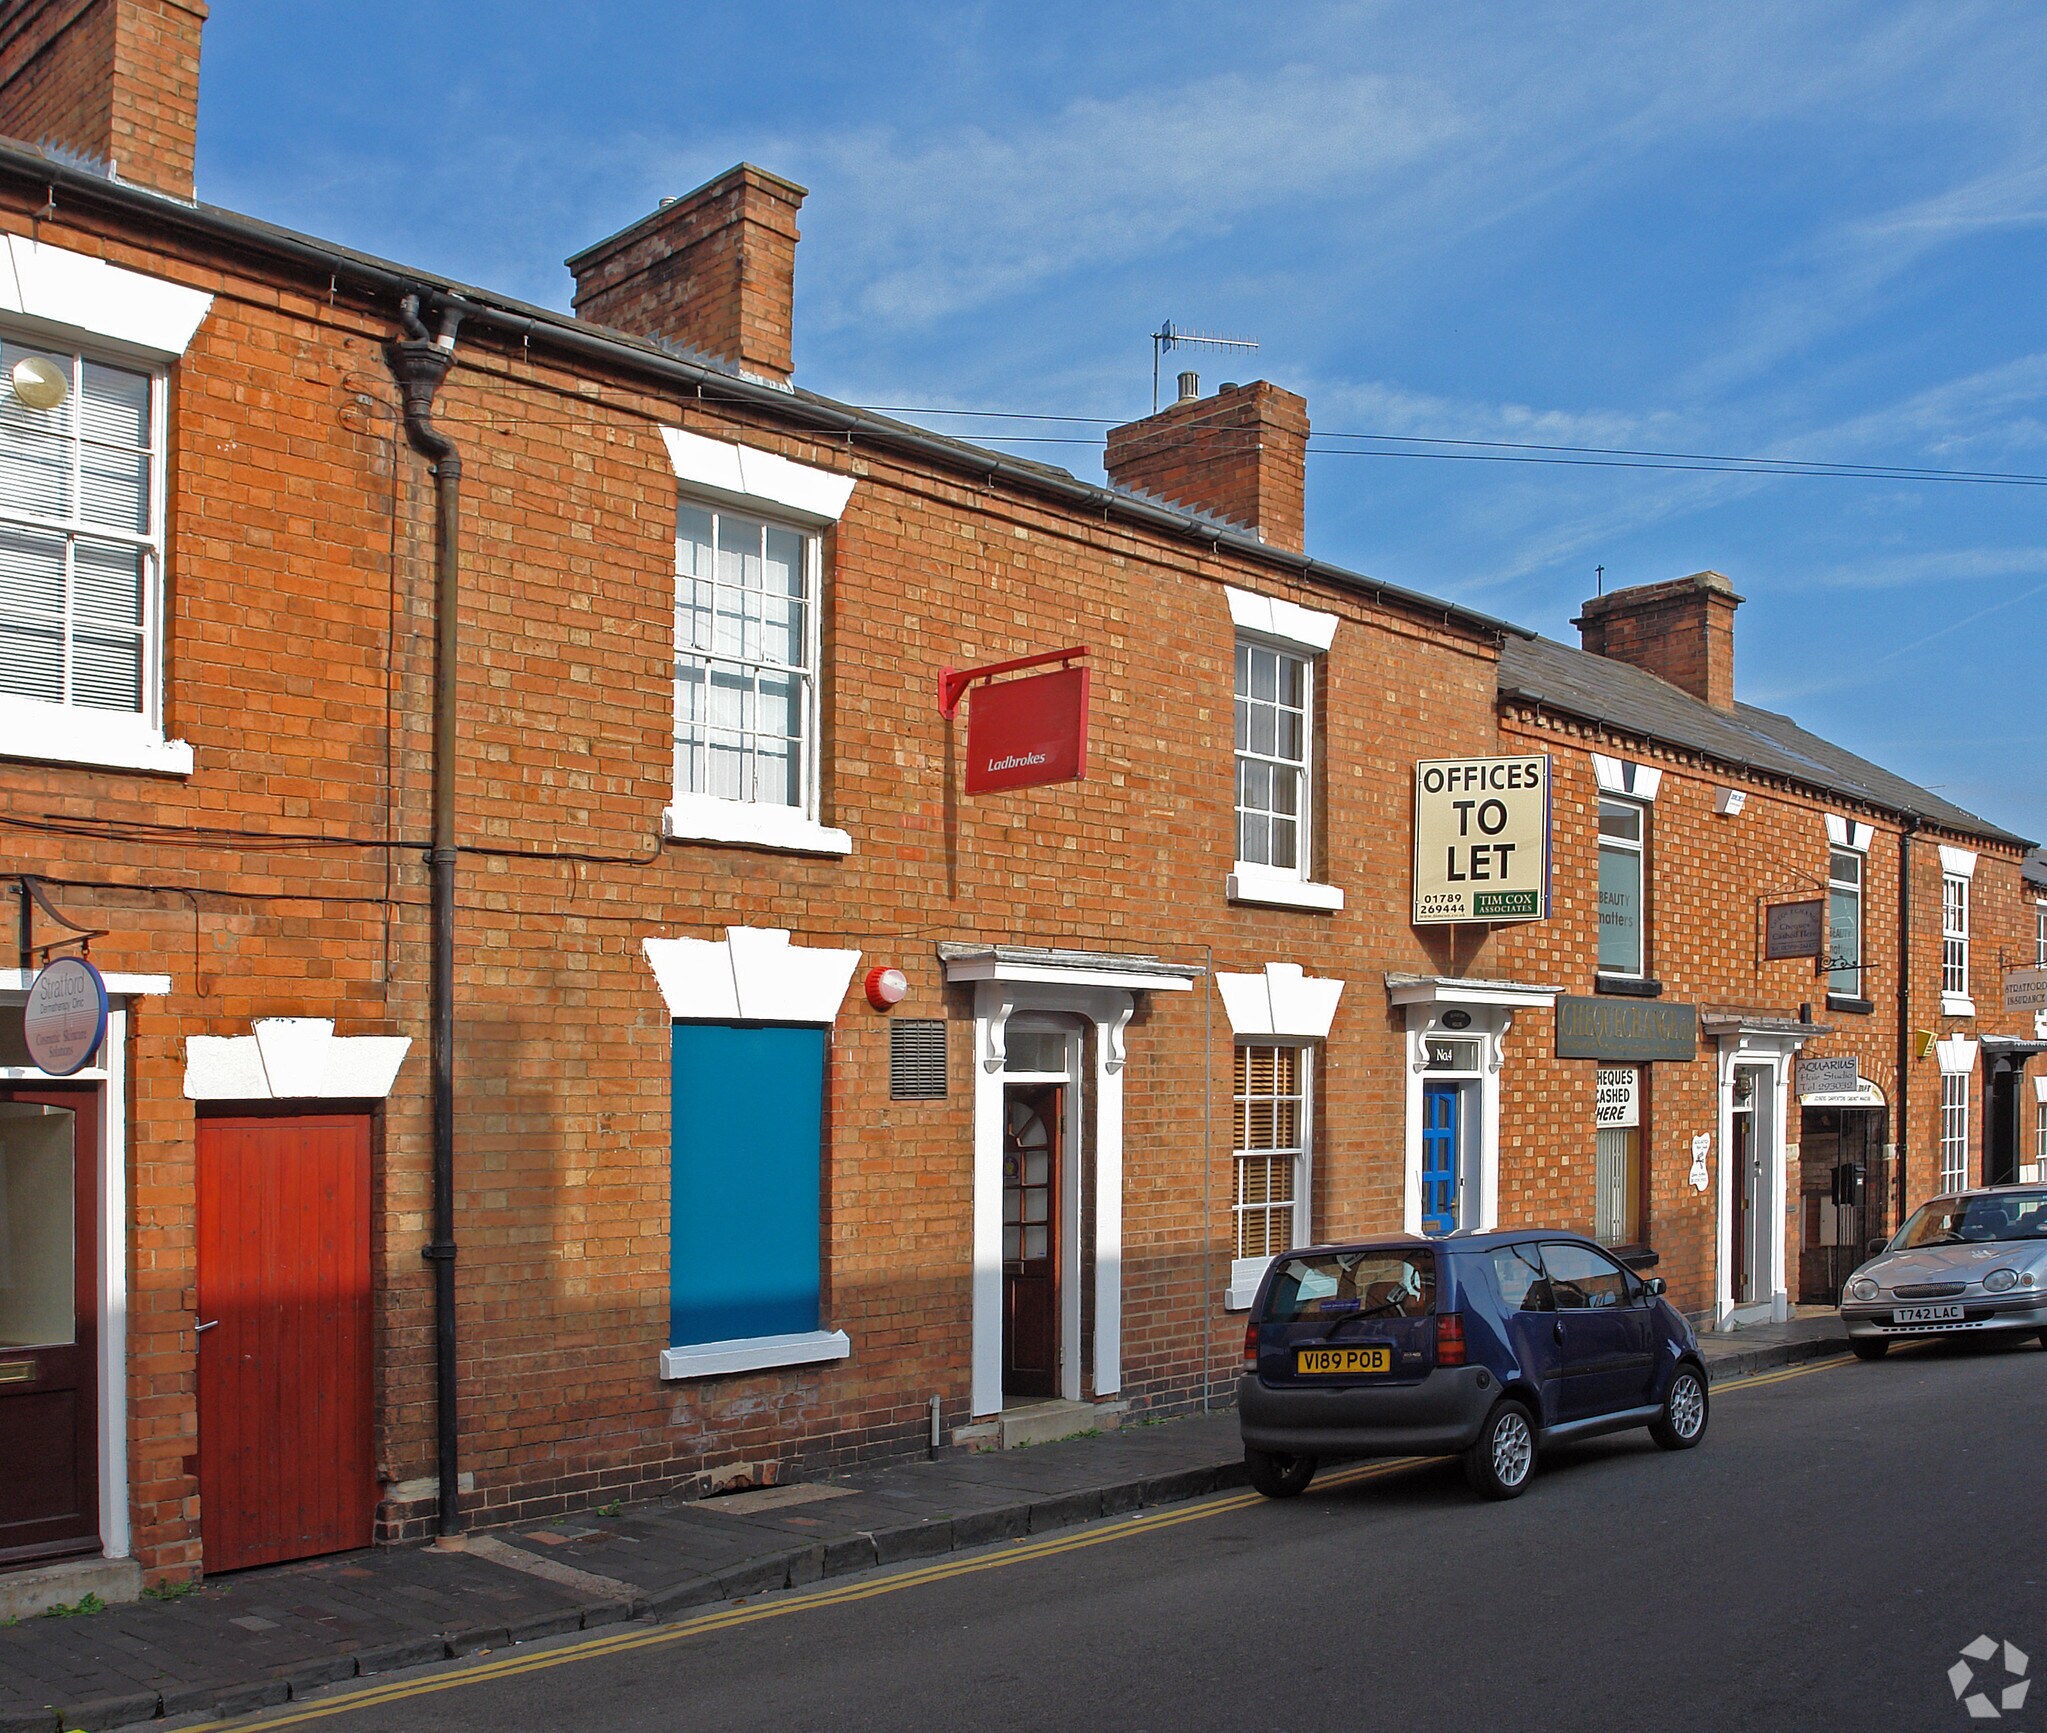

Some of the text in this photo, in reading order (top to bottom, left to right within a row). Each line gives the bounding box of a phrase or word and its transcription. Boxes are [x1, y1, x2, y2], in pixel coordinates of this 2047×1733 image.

[987, 751, 1046, 772] Ladbrokes
[1423, 763, 1539, 793] OFFICES
[1452, 798, 1508, 836] TO
[1447, 843, 1516, 882] LET
[1424, 894, 1463, 904] 01789
[1479, 894, 1532, 906] TIM COX
[1598, 891, 1630, 907] BEAUTY
[1420, 904, 1466, 914] 269444
[1479, 904, 1532, 913] ASSOCIATES
[40, 970, 85, 1001] Stratford
[2005, 981, 2047, 993] STRATFORD
[1798, 1059, 1855, 1073] AQUARIUS
[1801, 1070, 1853, 1082] Hair Studio
[1800, 1083, 1816, 1093] Tel
[1818, 1082, 1853, 1092] 293032
[1597, 1105, 1626, 1121] HERE
[1899, 1306, 1959, 1321] T742 LAC
[1304, 1351, 1383, 1370] V189 POB
